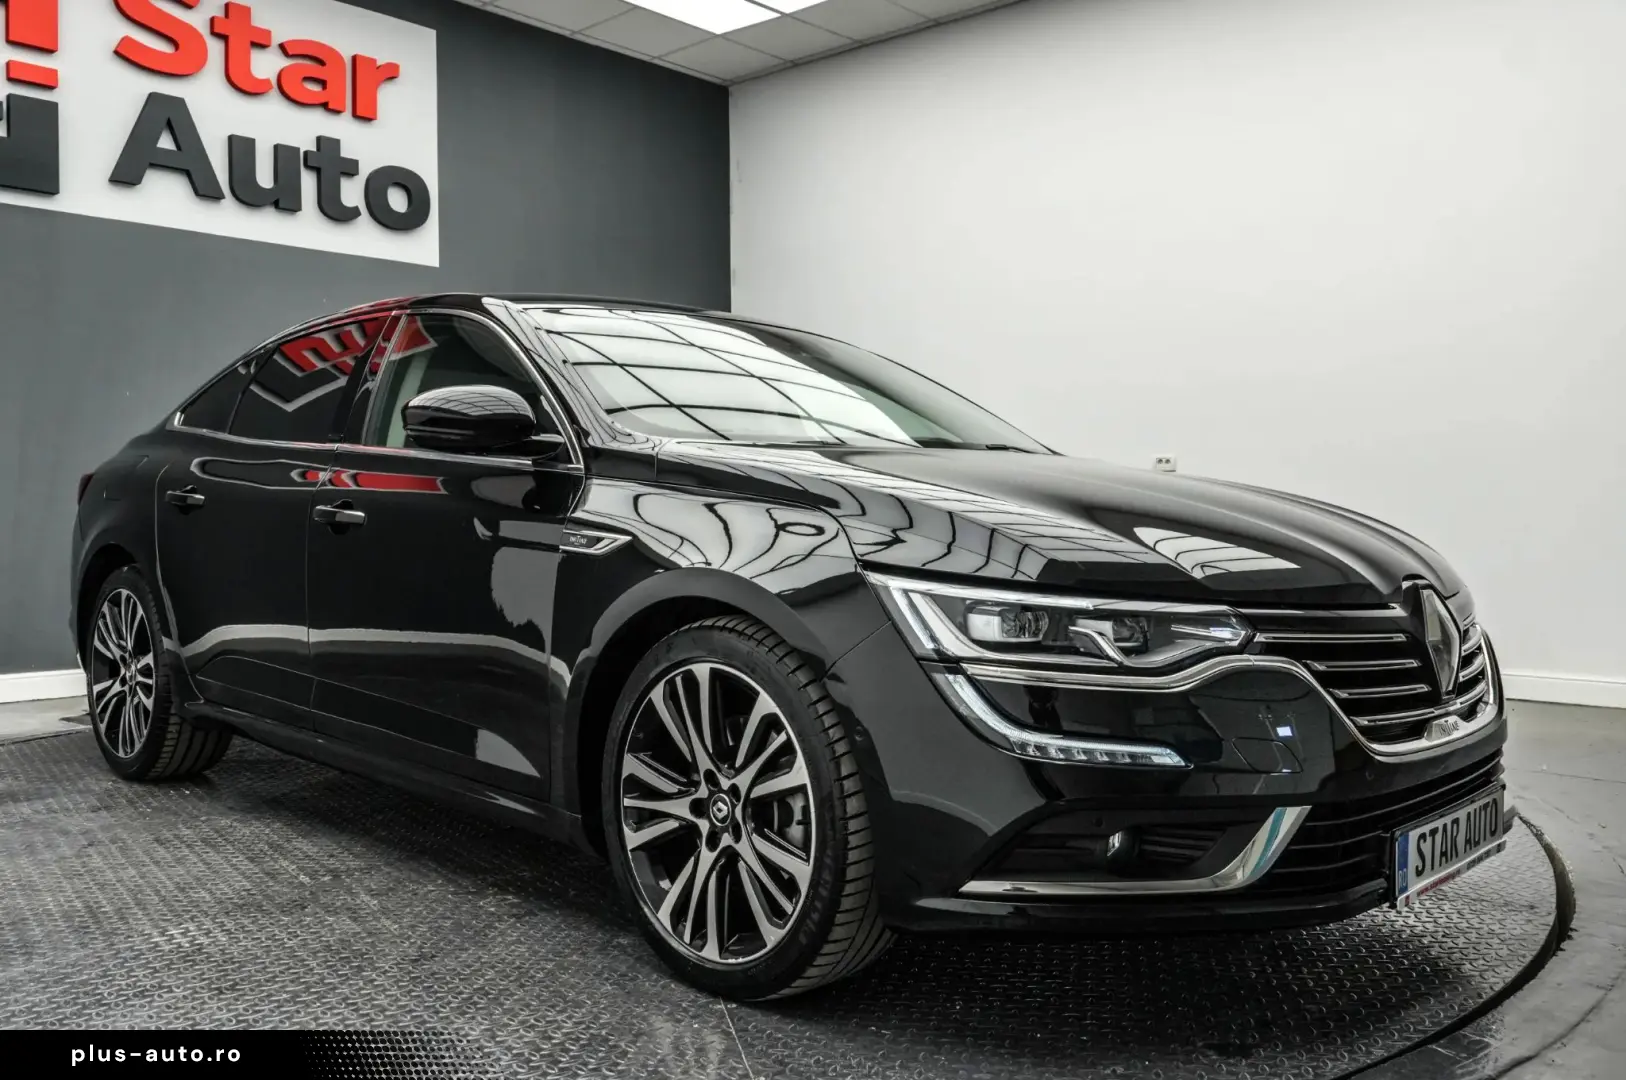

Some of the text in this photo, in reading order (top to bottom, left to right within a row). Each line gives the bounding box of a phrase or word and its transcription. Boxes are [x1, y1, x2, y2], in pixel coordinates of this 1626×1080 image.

[114, 0, 400, 121] Star
[109, 92, 431, 231] Auto
[1415, 817, 1460, 877] STAR
[1464, 798, 1498, 854] AUTO
